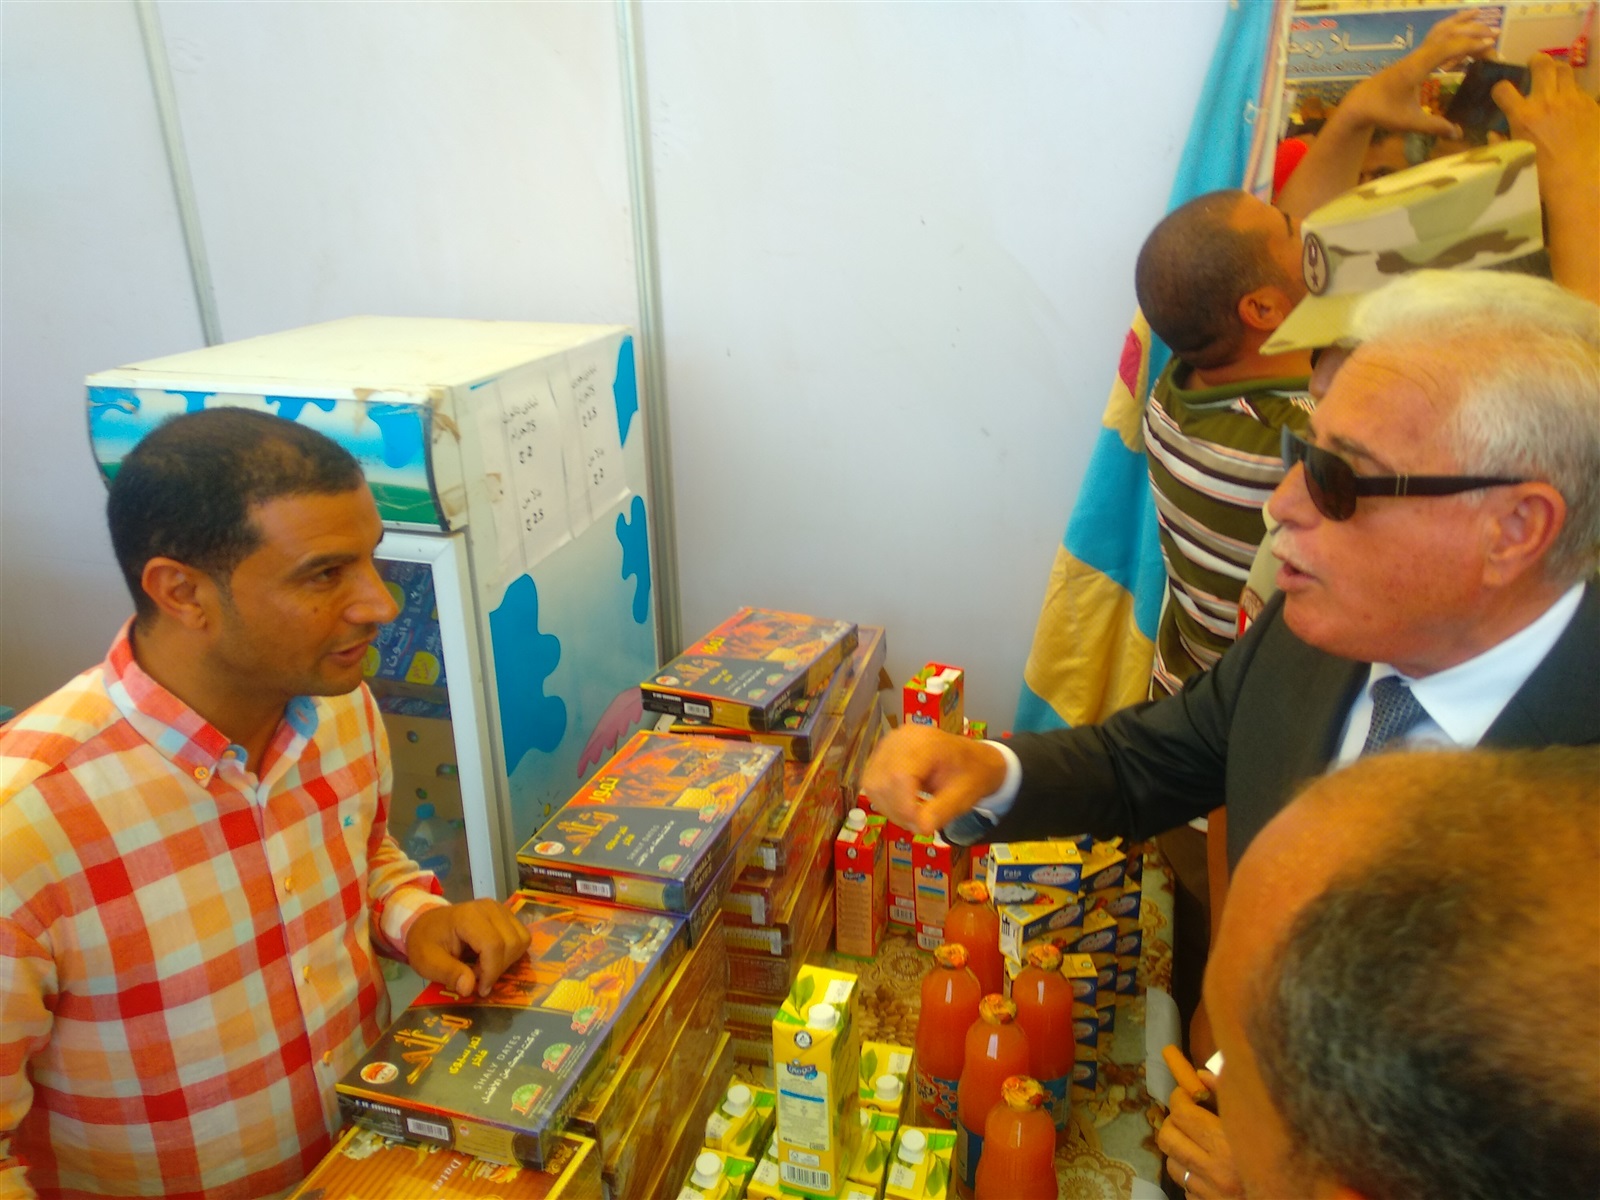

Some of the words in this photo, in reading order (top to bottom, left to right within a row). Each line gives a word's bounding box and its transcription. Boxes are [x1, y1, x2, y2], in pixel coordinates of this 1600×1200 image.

[588, 776, 620, 804] تمور
[473, 1062, 499, 1091] SHALY
[496, 1034, 521, 1061] DATES
[431, 1158, 462, 1192] Dates
